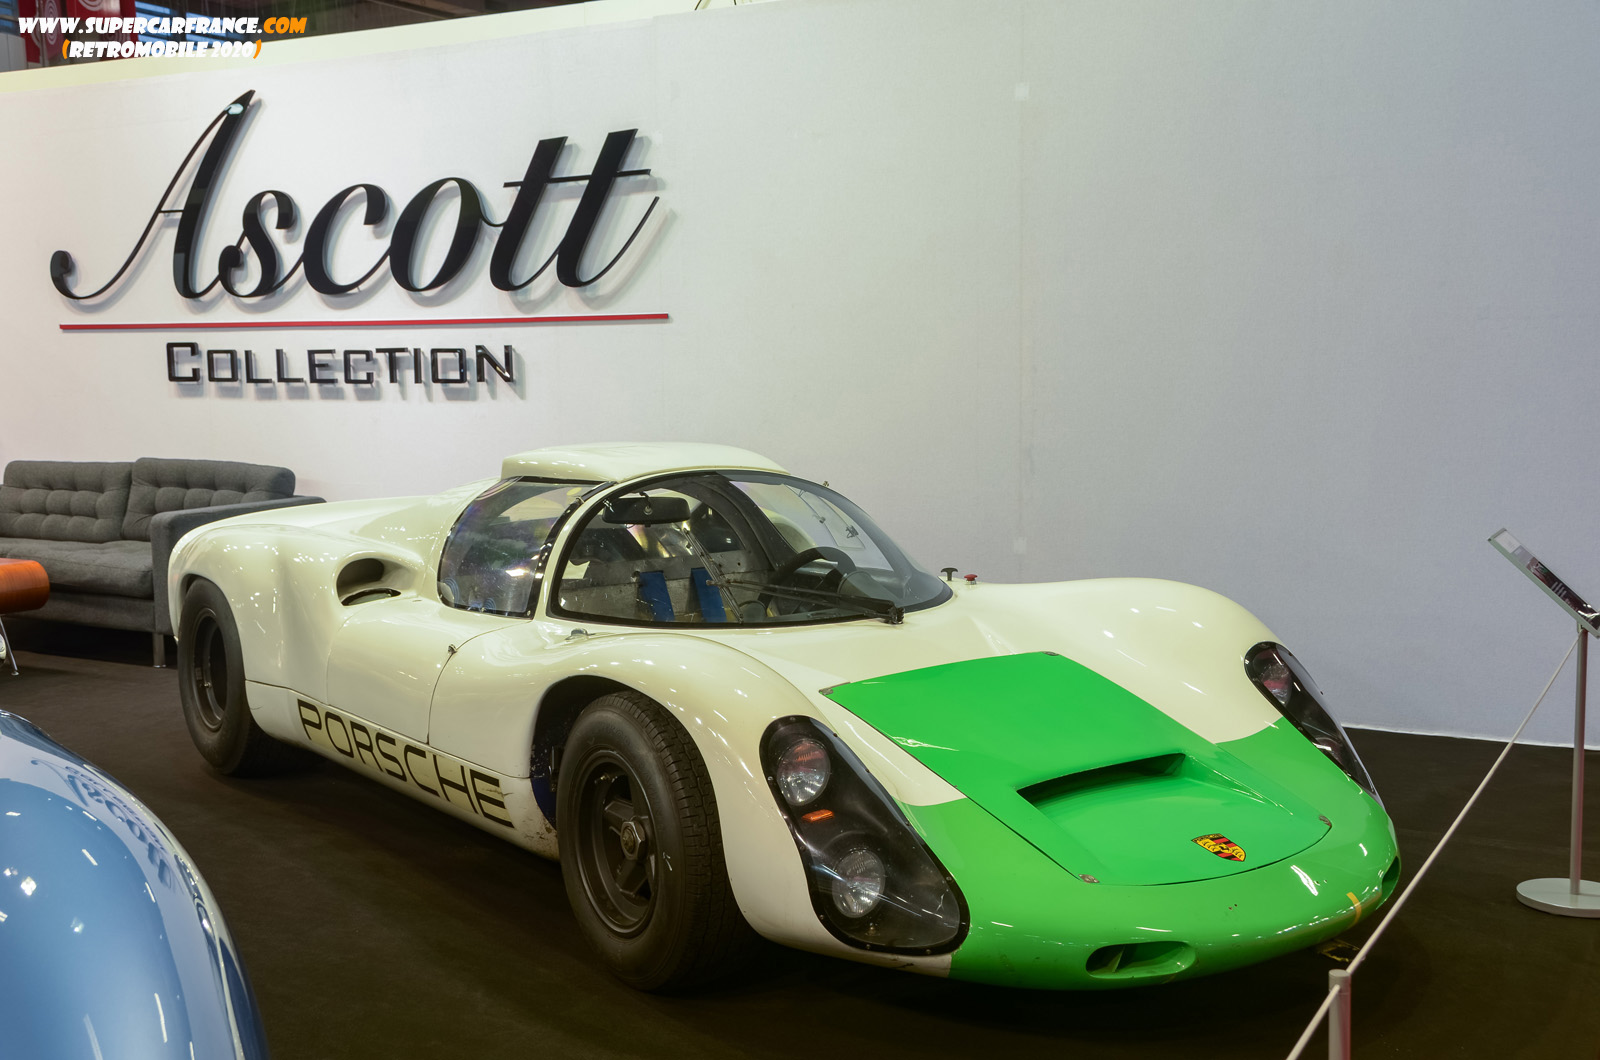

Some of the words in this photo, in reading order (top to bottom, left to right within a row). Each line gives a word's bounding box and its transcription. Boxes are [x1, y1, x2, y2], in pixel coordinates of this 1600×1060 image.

[50, 89, 660, 299] Ascott
[166, 341, 515, 384] COLLECTION
[297, 698, 515, 828] PORSCHE
